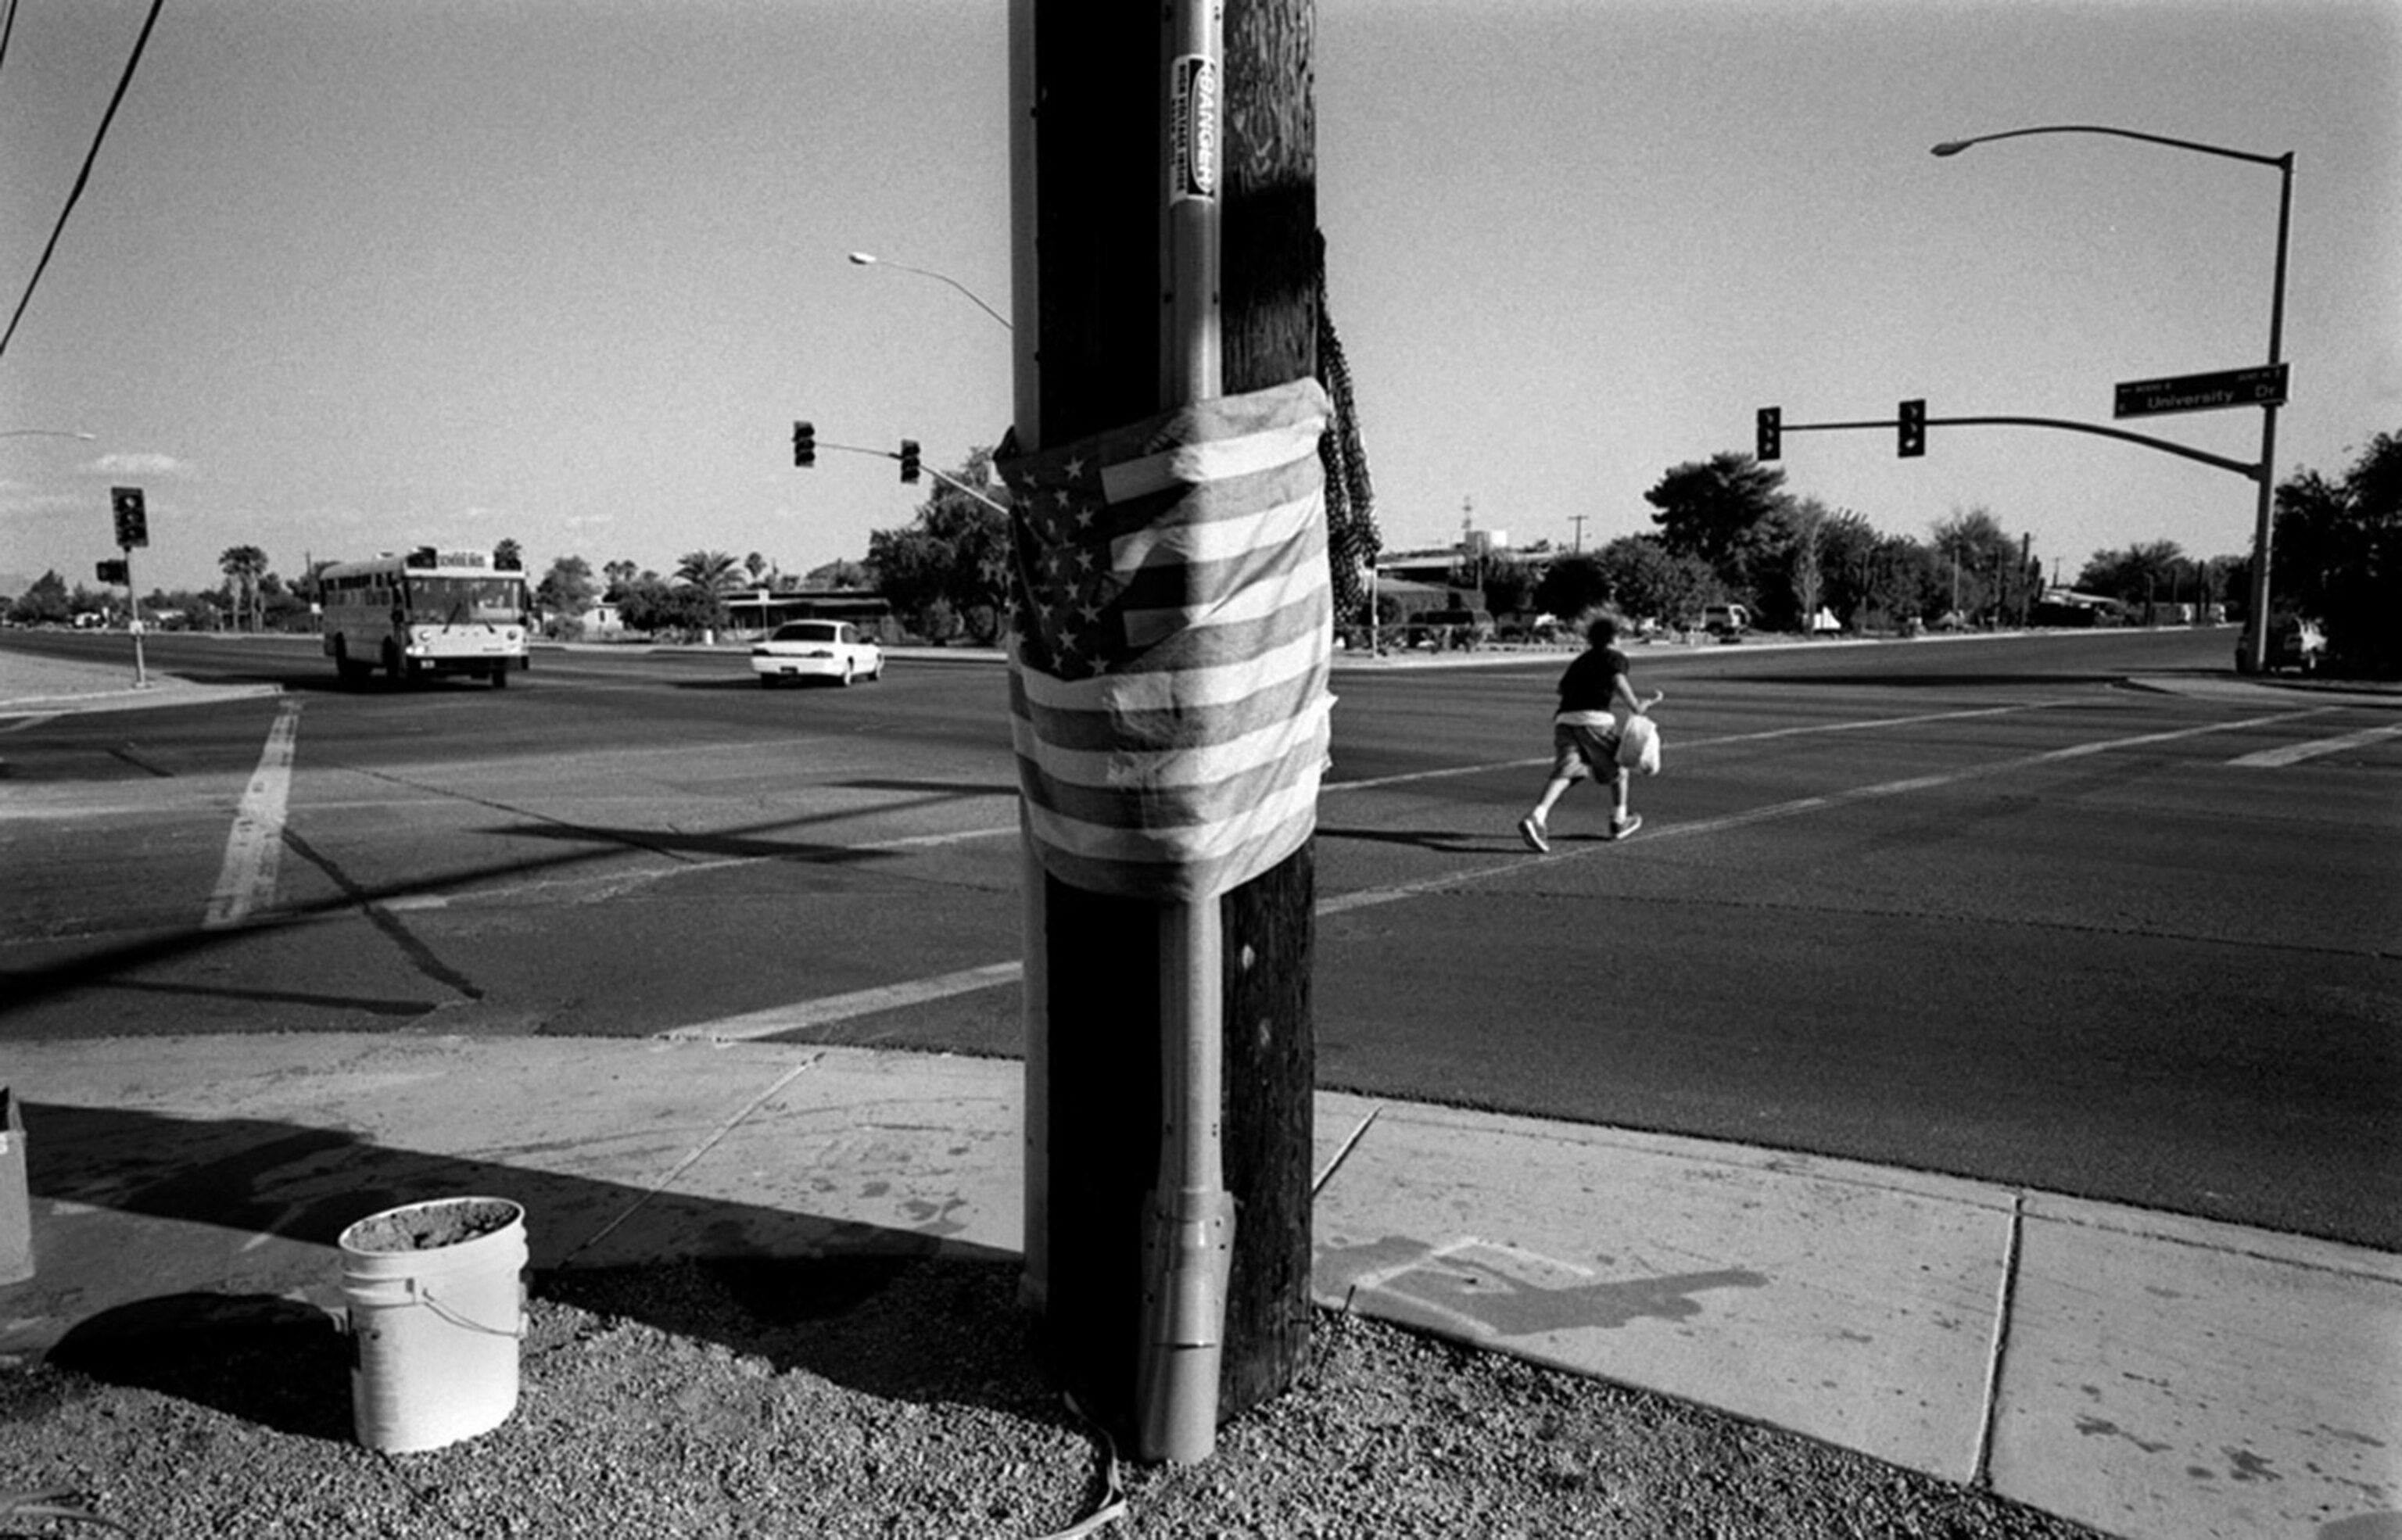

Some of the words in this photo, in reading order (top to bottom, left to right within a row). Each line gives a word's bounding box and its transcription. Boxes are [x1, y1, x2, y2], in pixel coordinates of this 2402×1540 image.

[1197, 76, 1214, 185] DANGER
[2146, 389, 2234, 410] University
[2254, 384, 2276, 399] Dr
